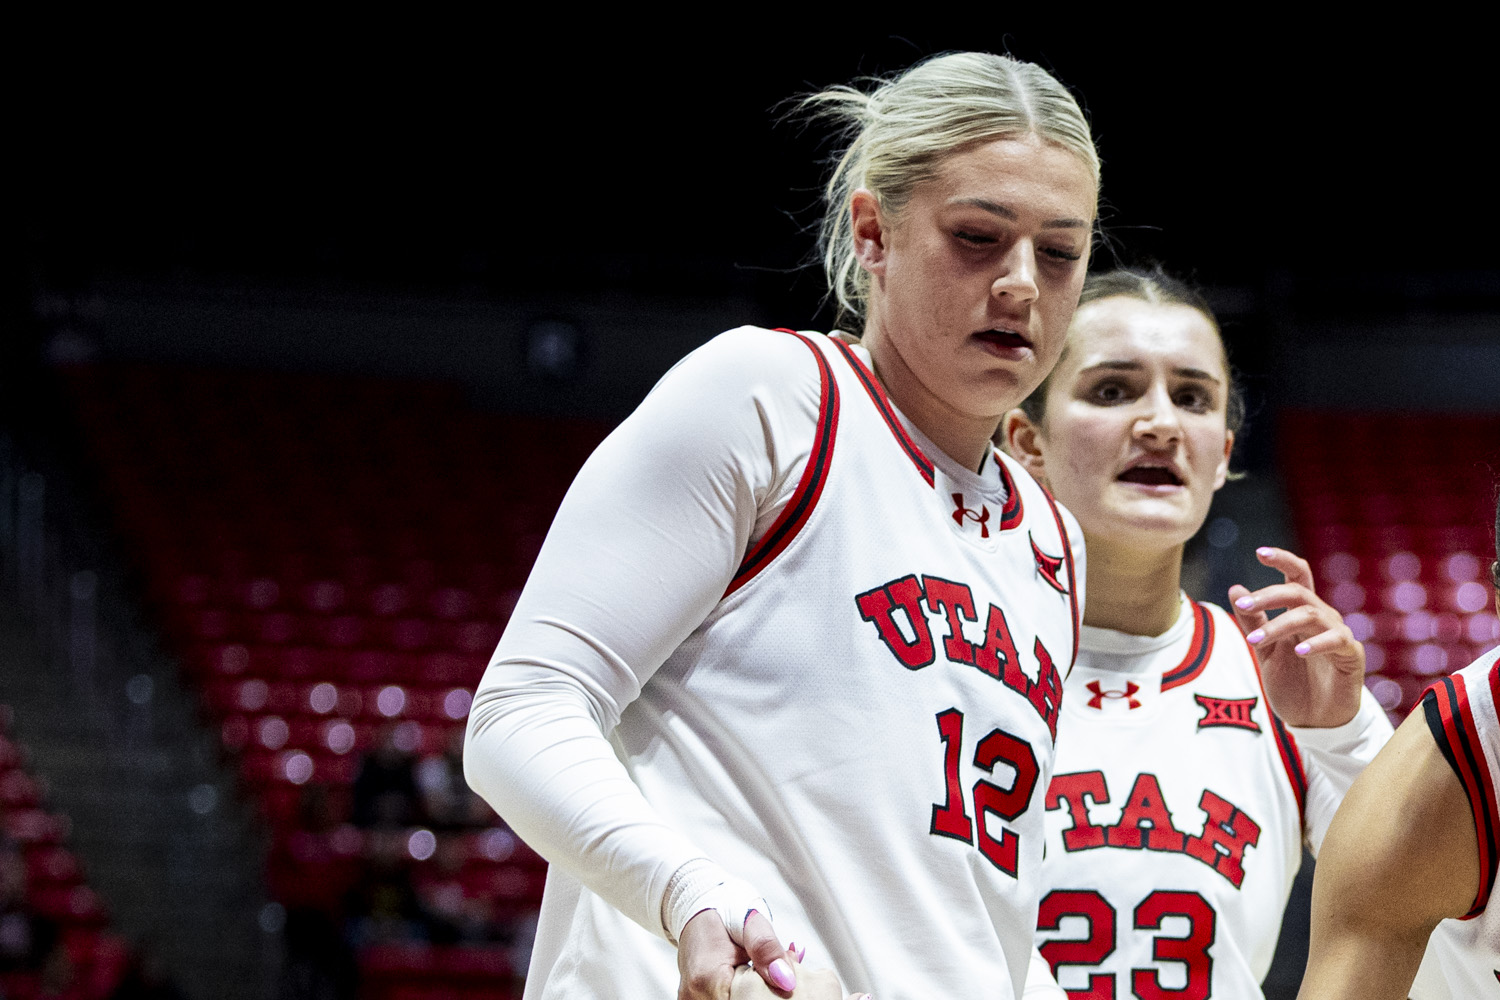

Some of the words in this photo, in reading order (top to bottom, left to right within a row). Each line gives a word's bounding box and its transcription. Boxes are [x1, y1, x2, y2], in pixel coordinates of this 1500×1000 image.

[855, 573, 1063, 749] UTAH
[929, 707, 1040, 879] 12
[1043, 770, 1261, 890] TAH
